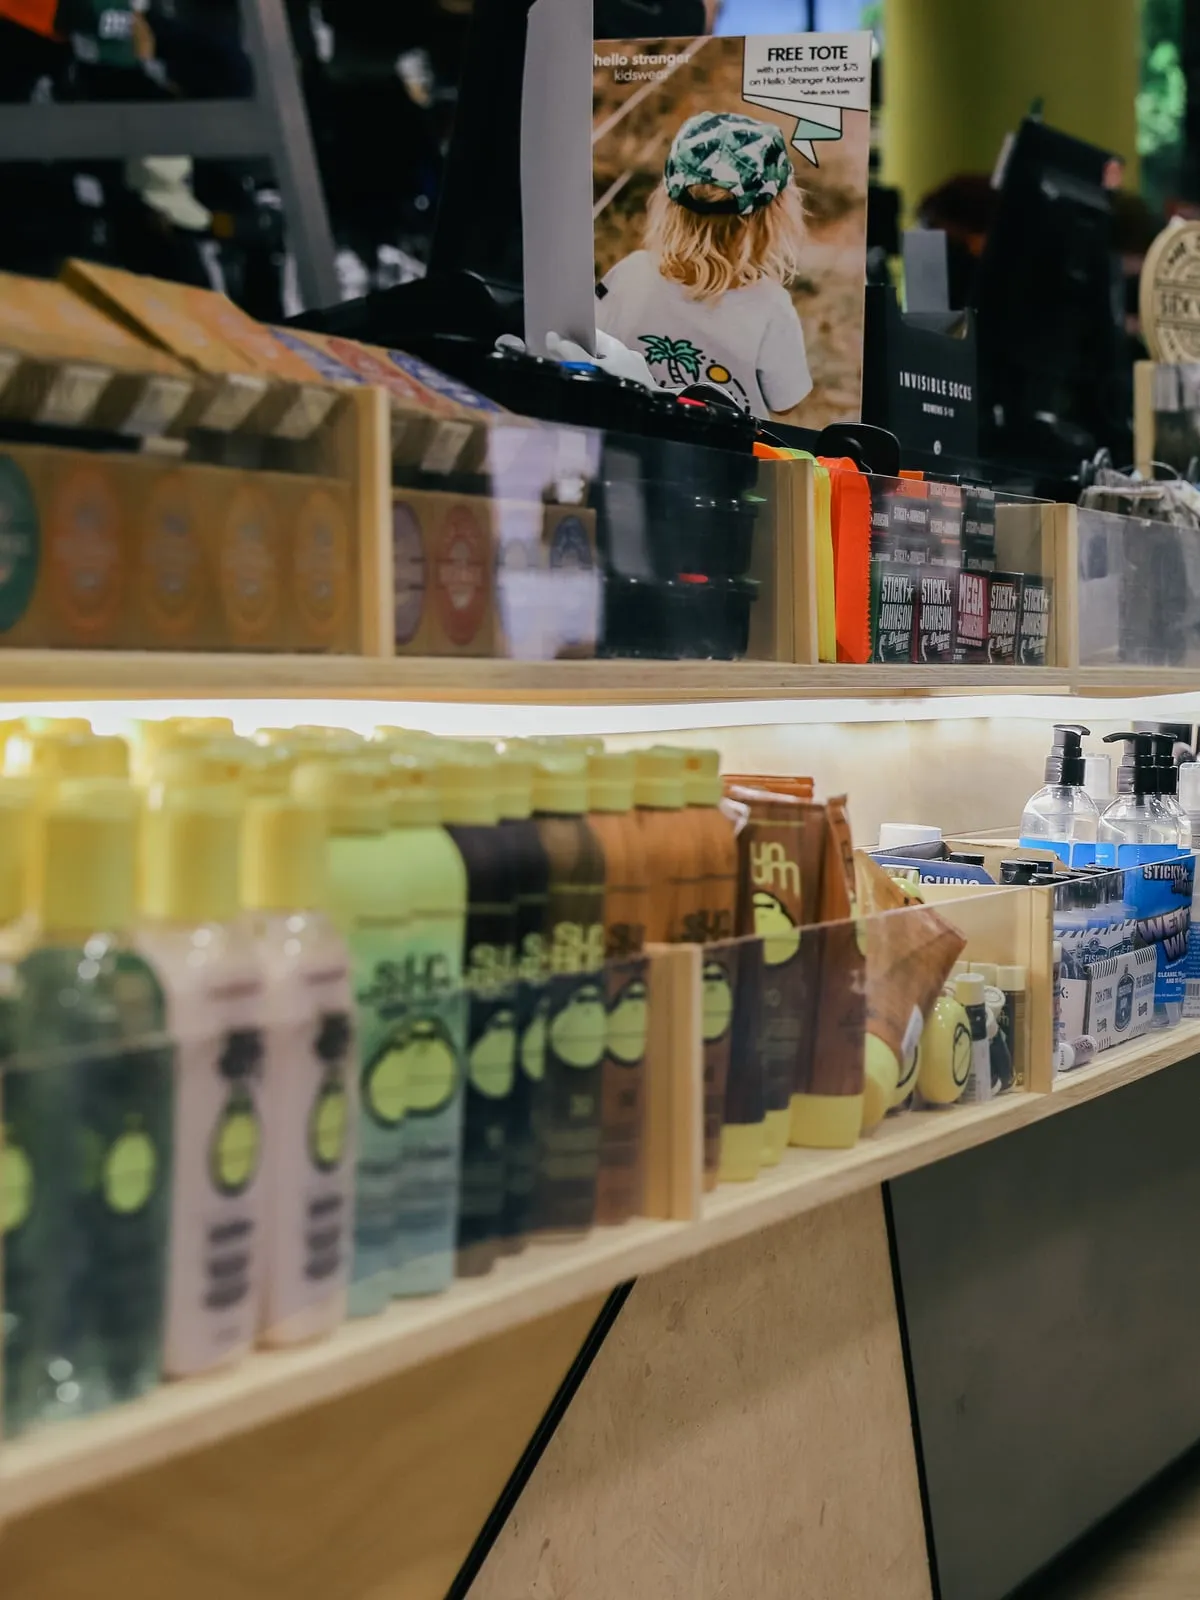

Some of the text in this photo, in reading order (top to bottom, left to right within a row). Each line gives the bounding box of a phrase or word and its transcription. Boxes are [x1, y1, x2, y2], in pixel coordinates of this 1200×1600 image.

[593, 53, 691, 66] hello stranger
[767, 46, 848, 61] FREE TOTE
[614, 69, 670, 82] kidswear
[763, 77, 785, 86] Hello
[788, 76, 823, 86] Stranger
[826, 75, 865, 84] Kidswear
[776, 65, 819, 75] purchases
[843, 62, 859, 72] $75
[899, 371, 972, 402] INVISIBLE SOCKS
[881, 575, 909, 603] STICKY
[921, 578, 947, 604] STICKY
[958, 573, 983, 617] MEGA
[990, 585, 1014, 610] STICKY
[1023, 587, 1045, 612] STICKY
[879, 603, 913, 630] JOHNSON
[920, 604, 952, 631] JOHNSON
[988, 610, 1017, 635] JOHNSON
[1143, 865, 1182, 880] STICKY
